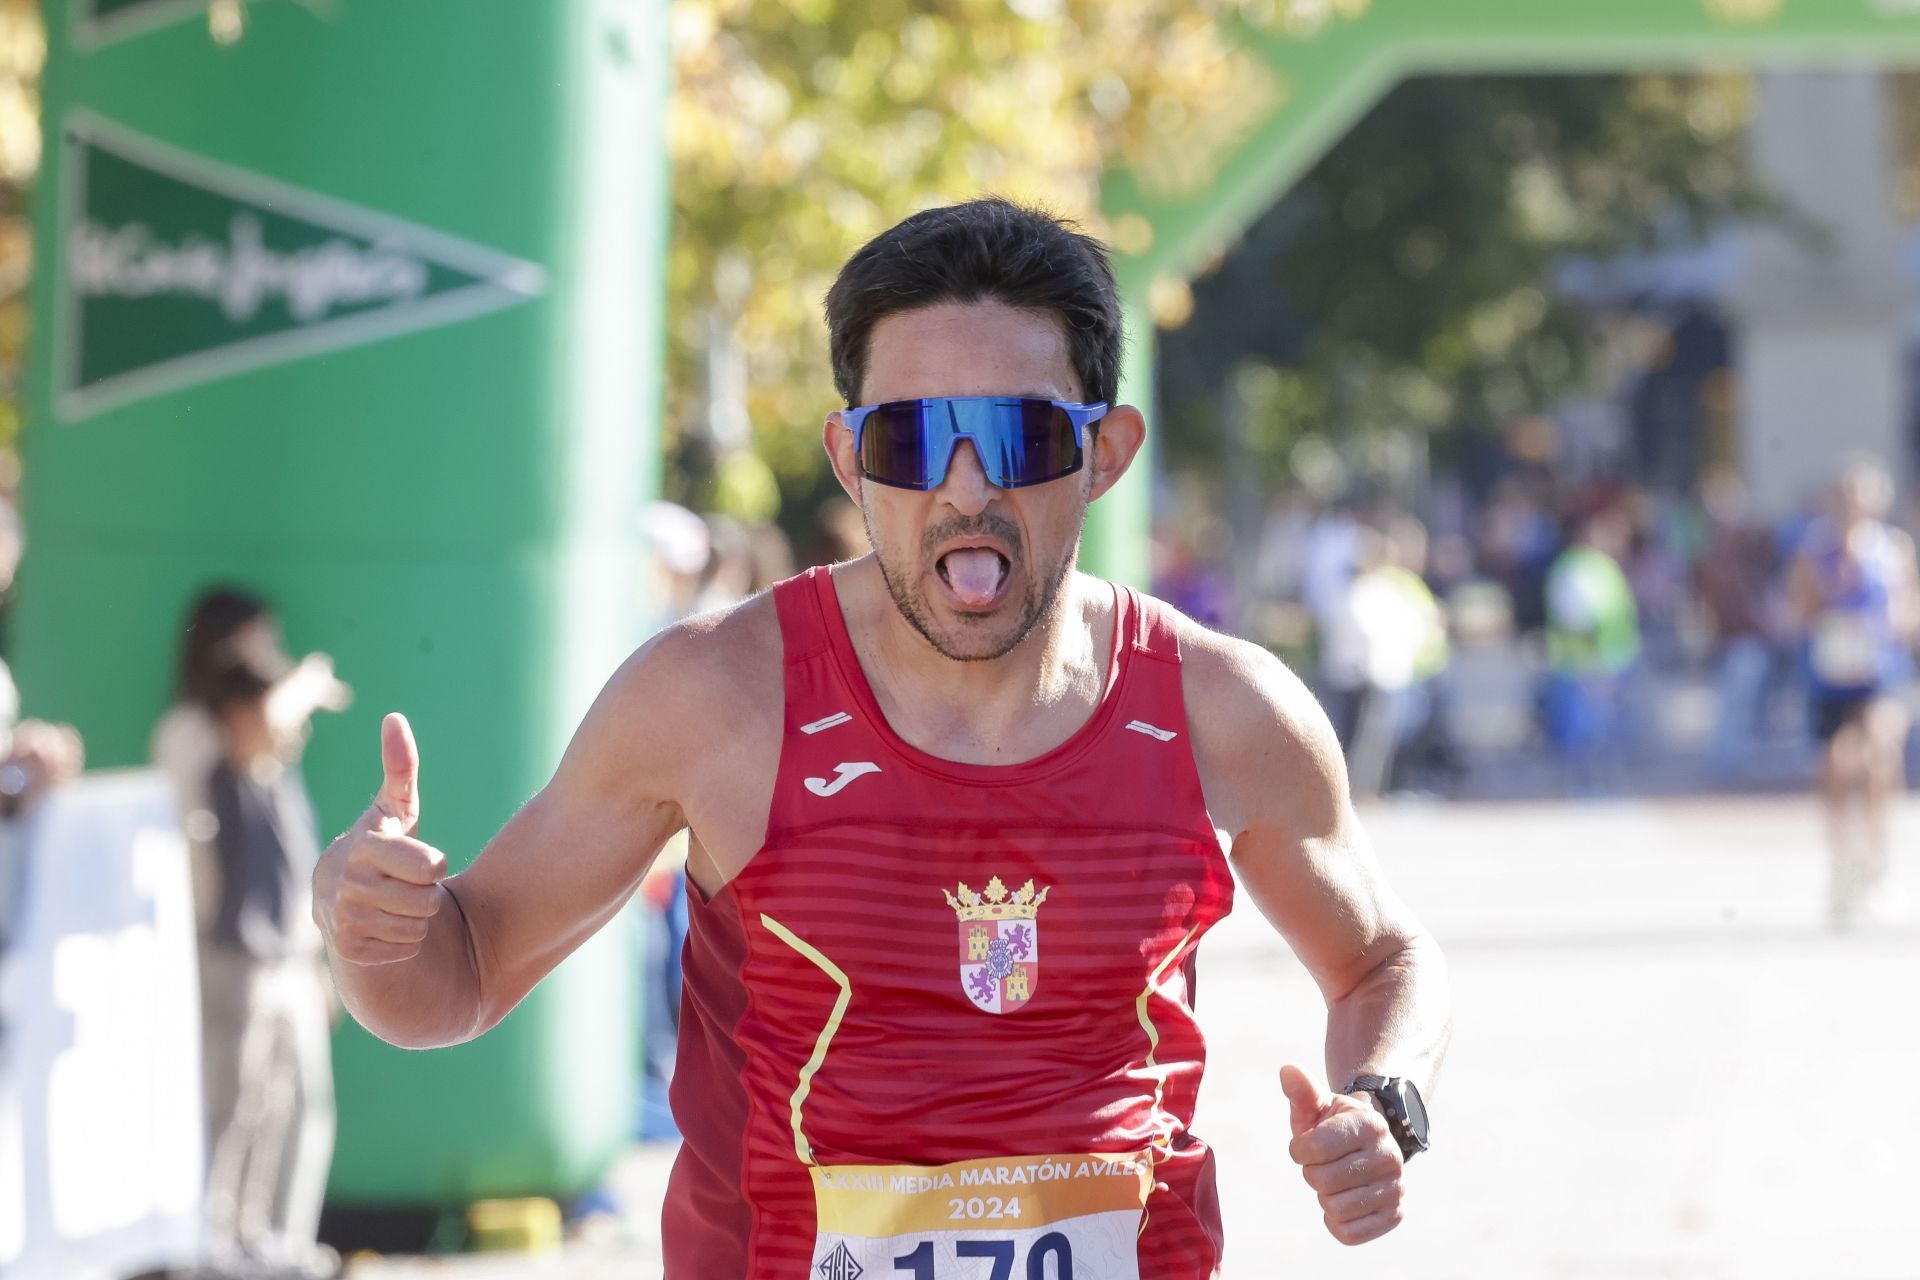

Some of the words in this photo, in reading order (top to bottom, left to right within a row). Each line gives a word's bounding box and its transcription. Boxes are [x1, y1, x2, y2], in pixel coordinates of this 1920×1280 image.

[889, 1173, 954, 1193] MEDIA
[960, 1158, 1071, 1186] MARATÓN
[948, 1196, 1021, 1219] 2024
